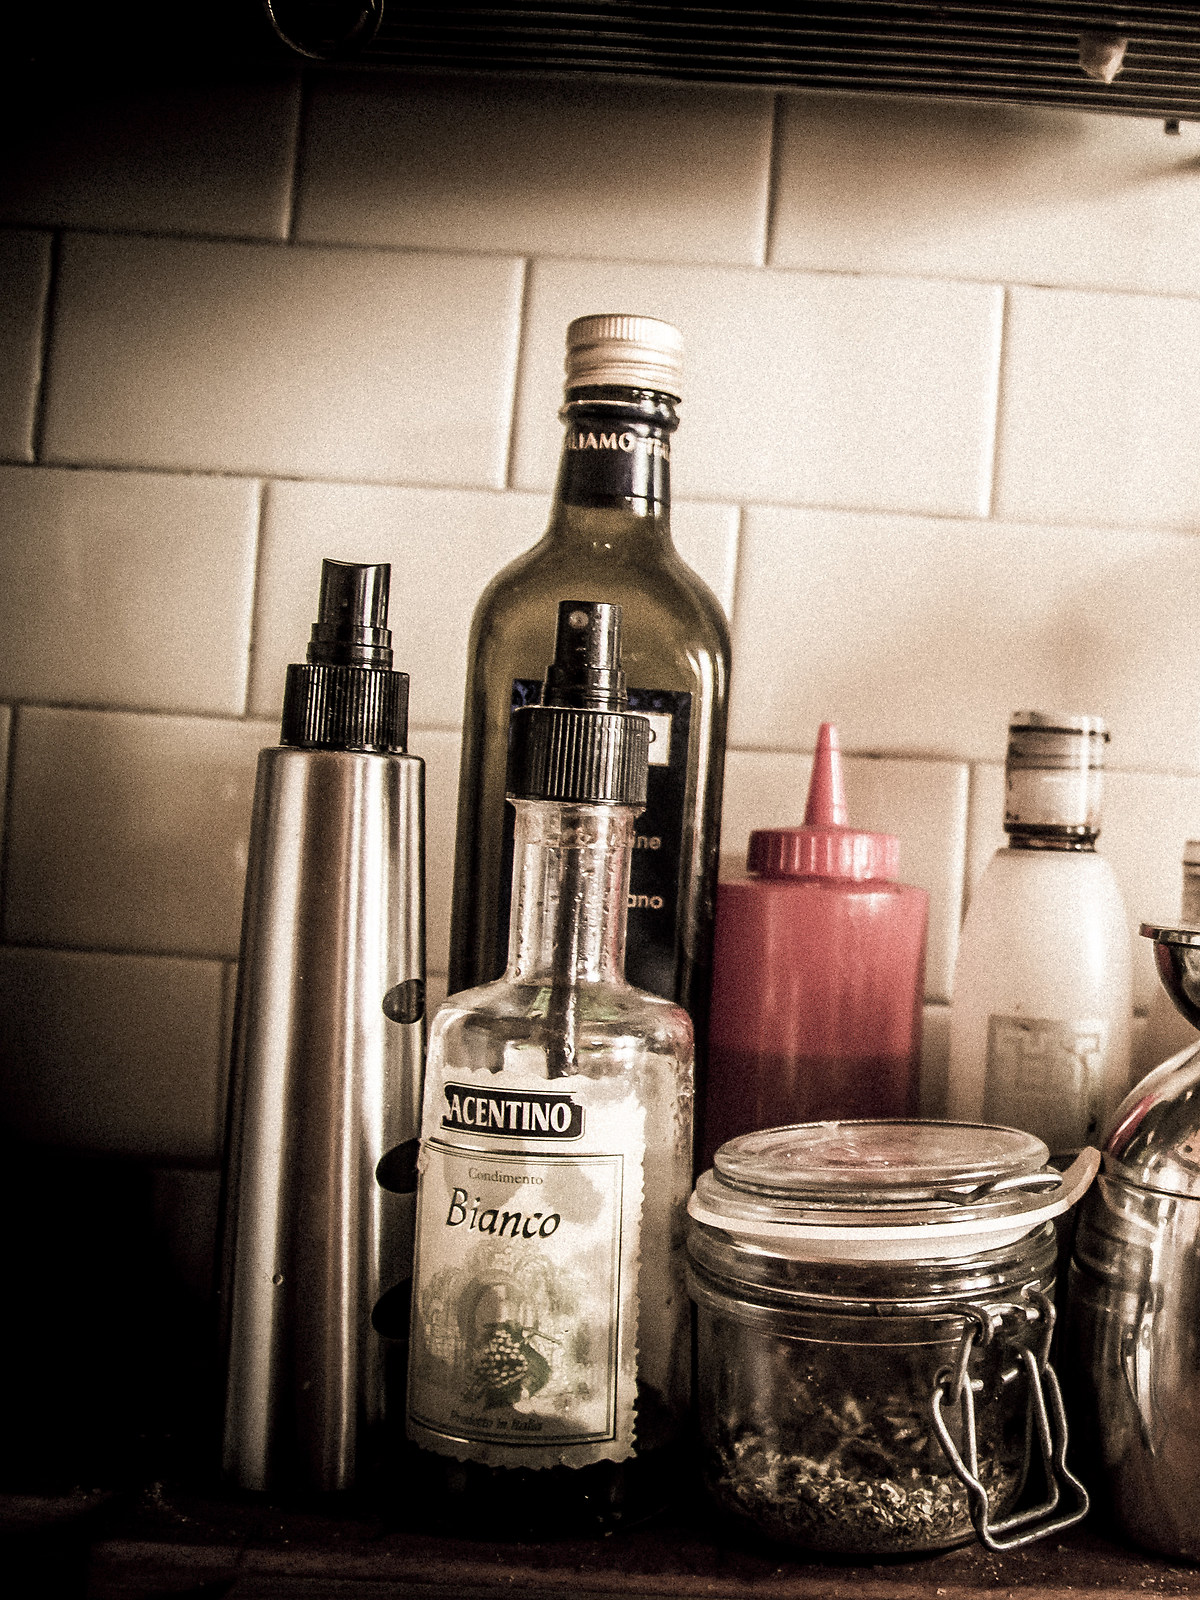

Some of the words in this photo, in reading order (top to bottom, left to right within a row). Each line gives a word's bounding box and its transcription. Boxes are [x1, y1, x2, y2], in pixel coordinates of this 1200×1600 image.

[446, 1093, 572, 1133] ACENTINO
[468, 1167, 544, 1185] Condimento
[445, 1187, 561, 1239] Bianco
